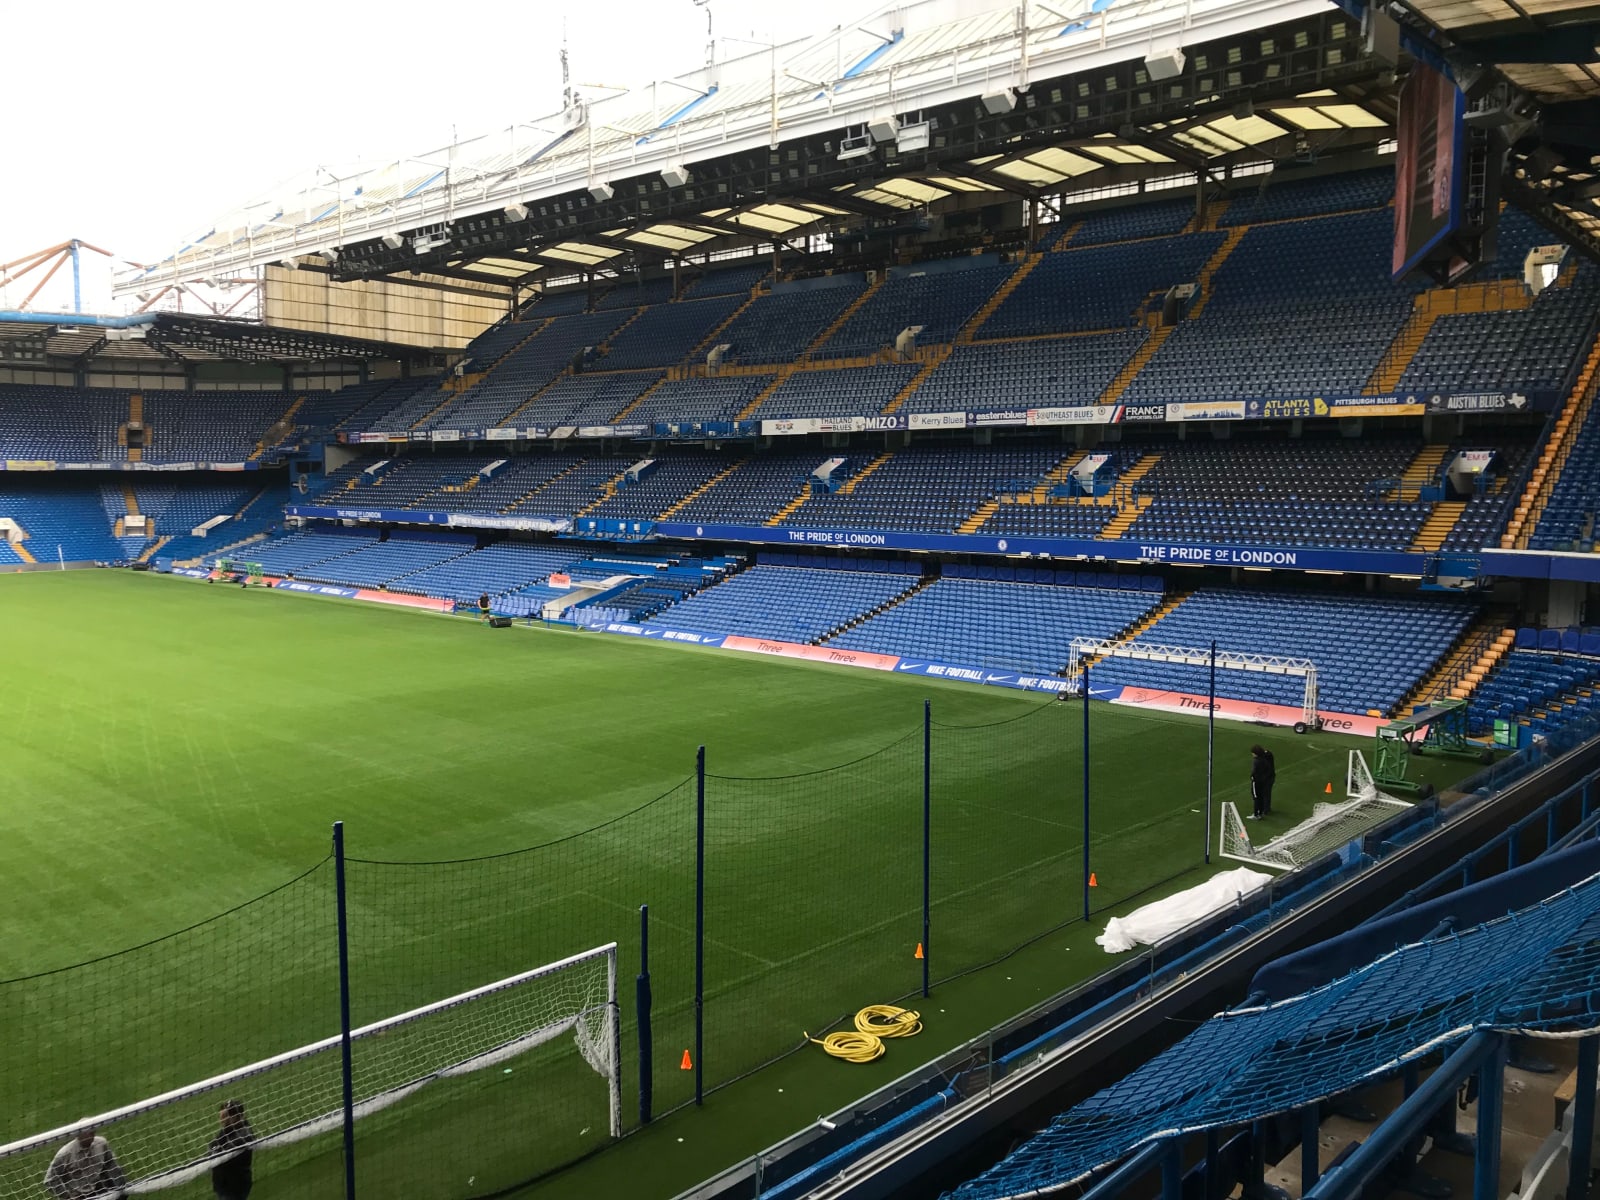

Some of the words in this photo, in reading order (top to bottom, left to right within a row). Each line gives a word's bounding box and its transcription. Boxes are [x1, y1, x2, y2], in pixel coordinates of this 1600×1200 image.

[1265, 399, 1310, 409] ATLANTA
[1447, 396, 1477, 409] AUSTIN
[1479, 395, 1506, 408] BLUES
[976, 410, 1027, 420] easternblues
[1036, 411, 1073, 419] SOUTHEAST
[1074, 410, 1094, 418] BLUES
[1126, 406, 1164, 415] FRANCE
[1264, 408, 1310, 417] BLUES
[821, 417, 852, 425] THAILAND
[866, 416, 897, 429] MIZO
[921, 417, 941, 426] Kerry
[943, 415, 964, 424] Blues
[788, 531, 805, 541] THE
[807, 531, 833, 542] PRIDE
[845, 533, 885, 545] LONDON
[1140, 546, 1166, 558] THE
[1170, 547, 1212, 561] PRIDE
[1215, 549, 1229, 558] OF
[1232, 550, 1297, 565] LONDON
[757, 642, 783, 653] Three
[829, 651, 857, 663] Three
[926, 664, 946, 674] NIKE
[945, 666, 983, 680] FOOTBALL
[1017, 677, 1039, 687] NIKE
[1180, 696, 1222, 712] Three
[1313, 714, 1353, 730] hree
